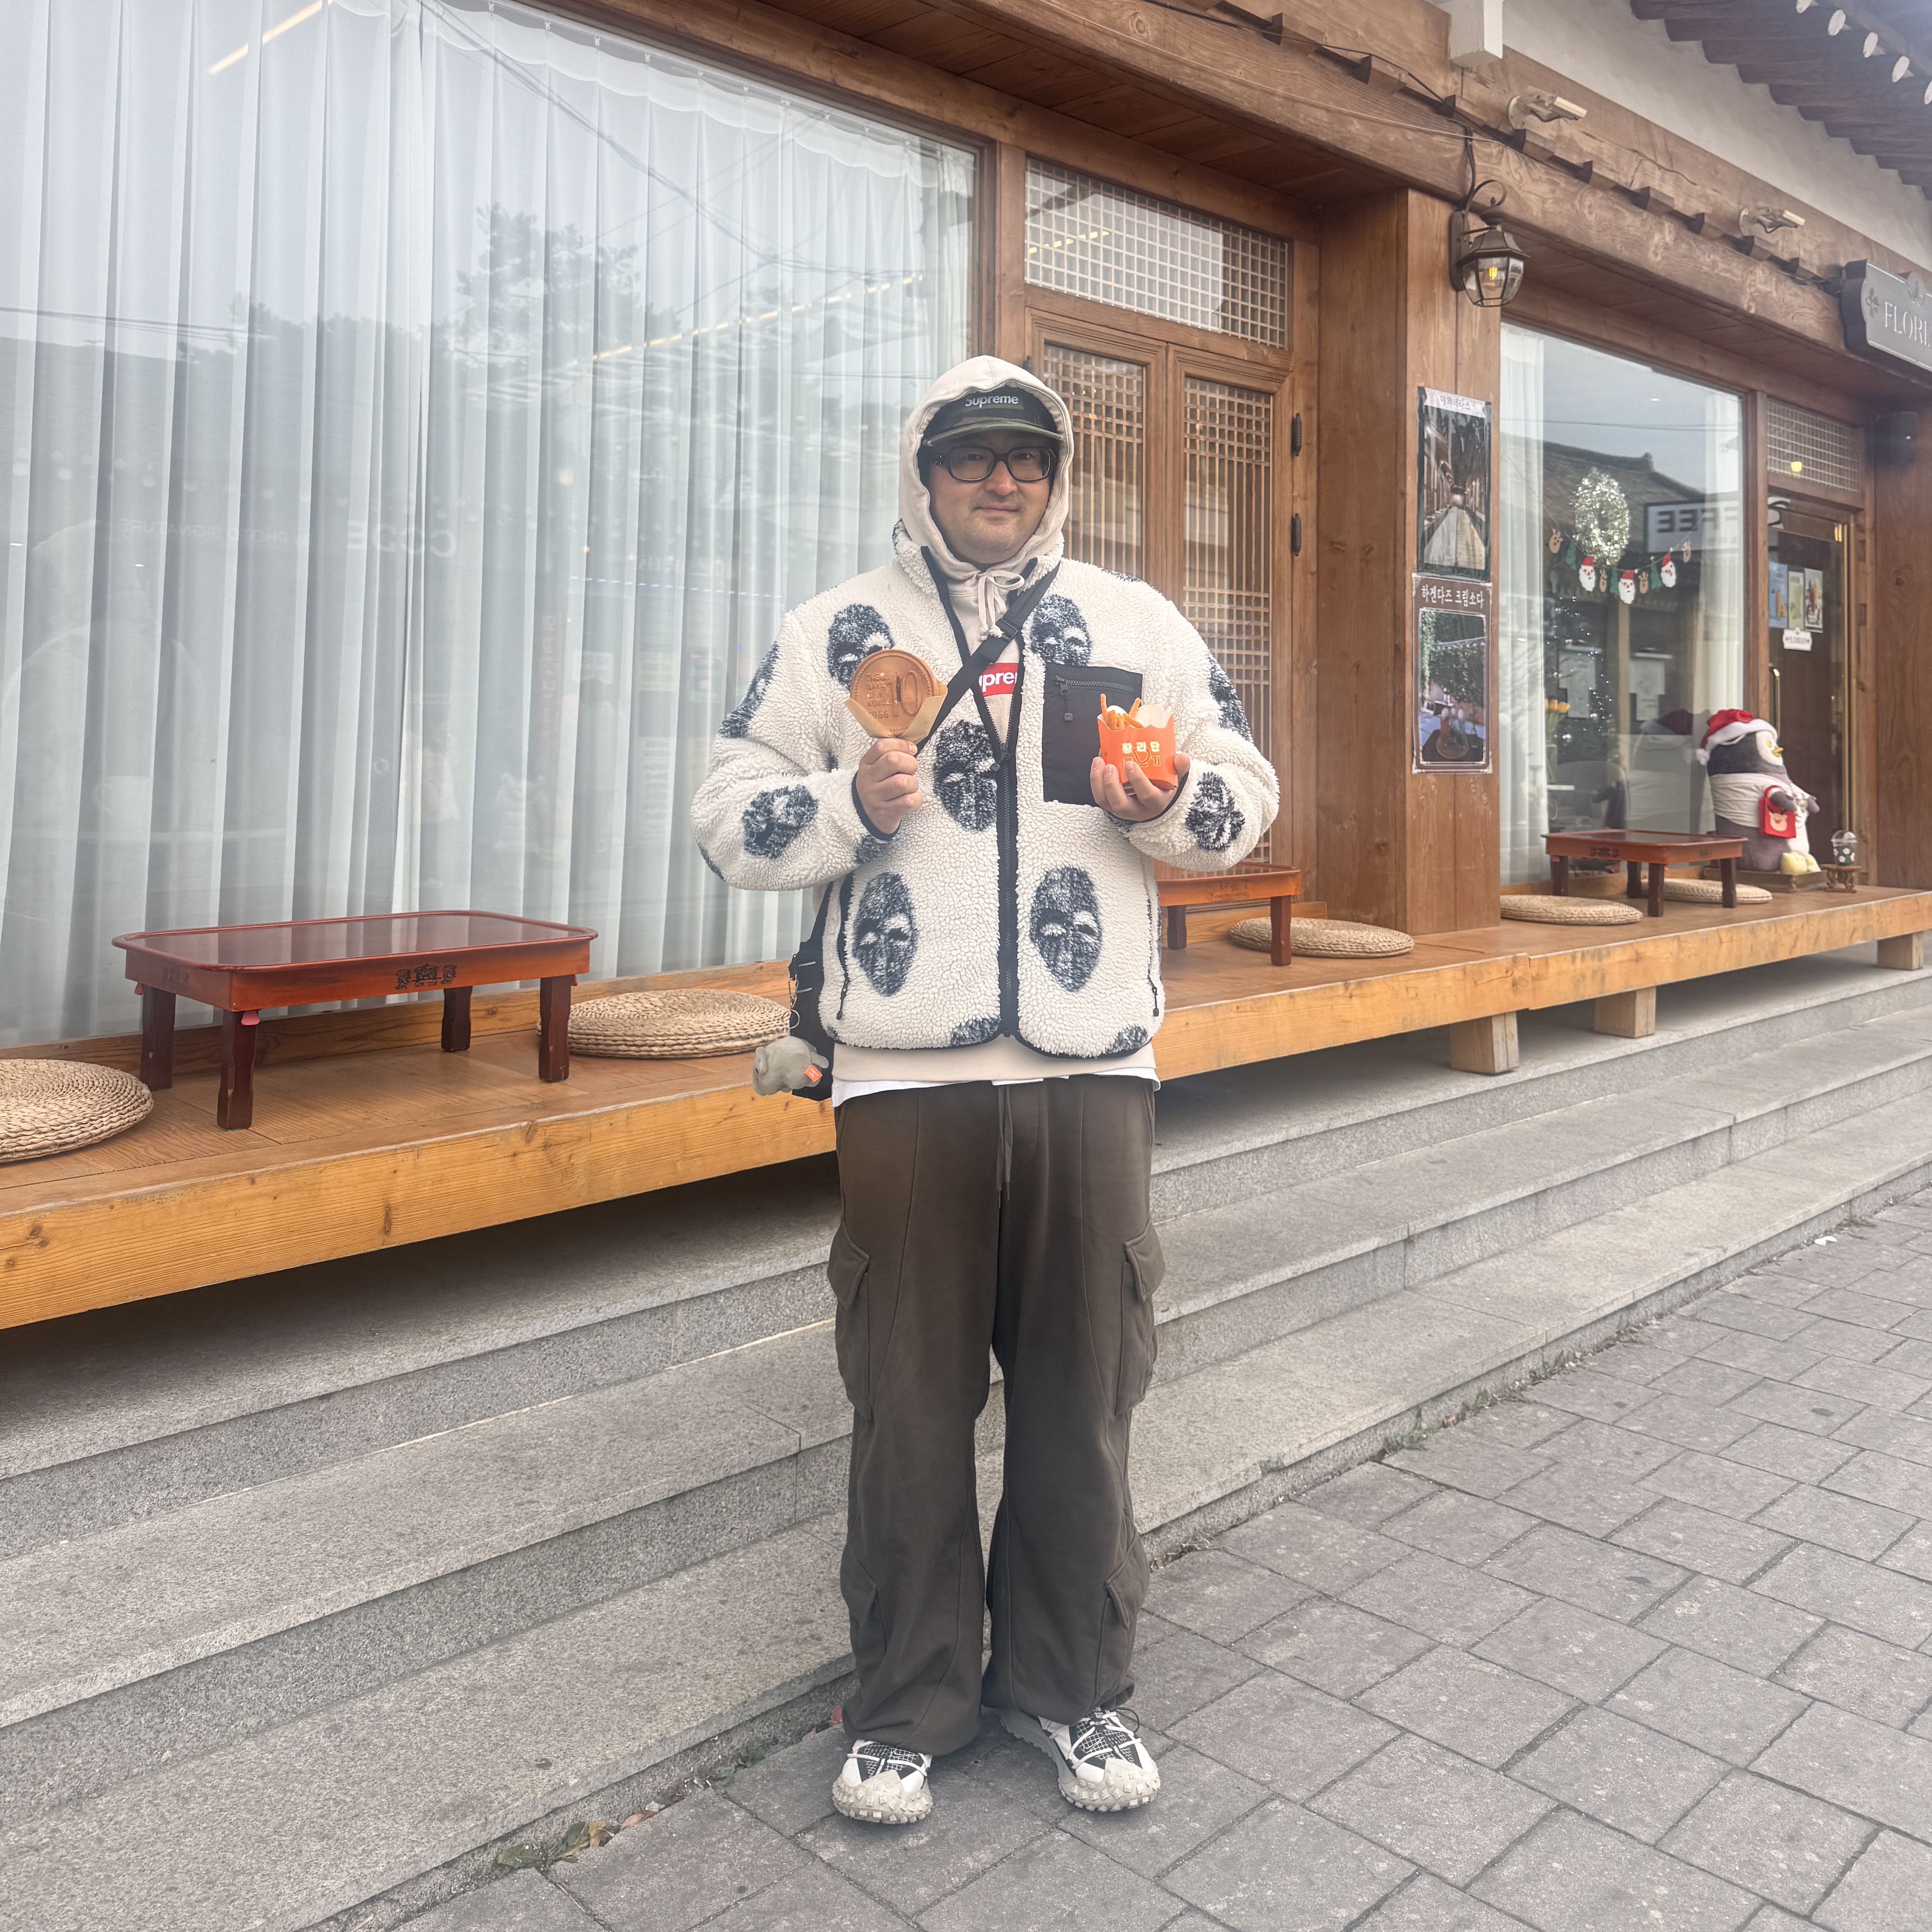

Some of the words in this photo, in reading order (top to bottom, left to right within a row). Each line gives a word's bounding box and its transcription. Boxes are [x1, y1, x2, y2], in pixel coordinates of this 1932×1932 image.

[1885, 302, 1930, 347] FLORI
[965, 396, 1019, 408] Supreme
[1421, 584, 1452, 605] 하겐다즈
[1454, 589, 1484, 609] 크림소다
